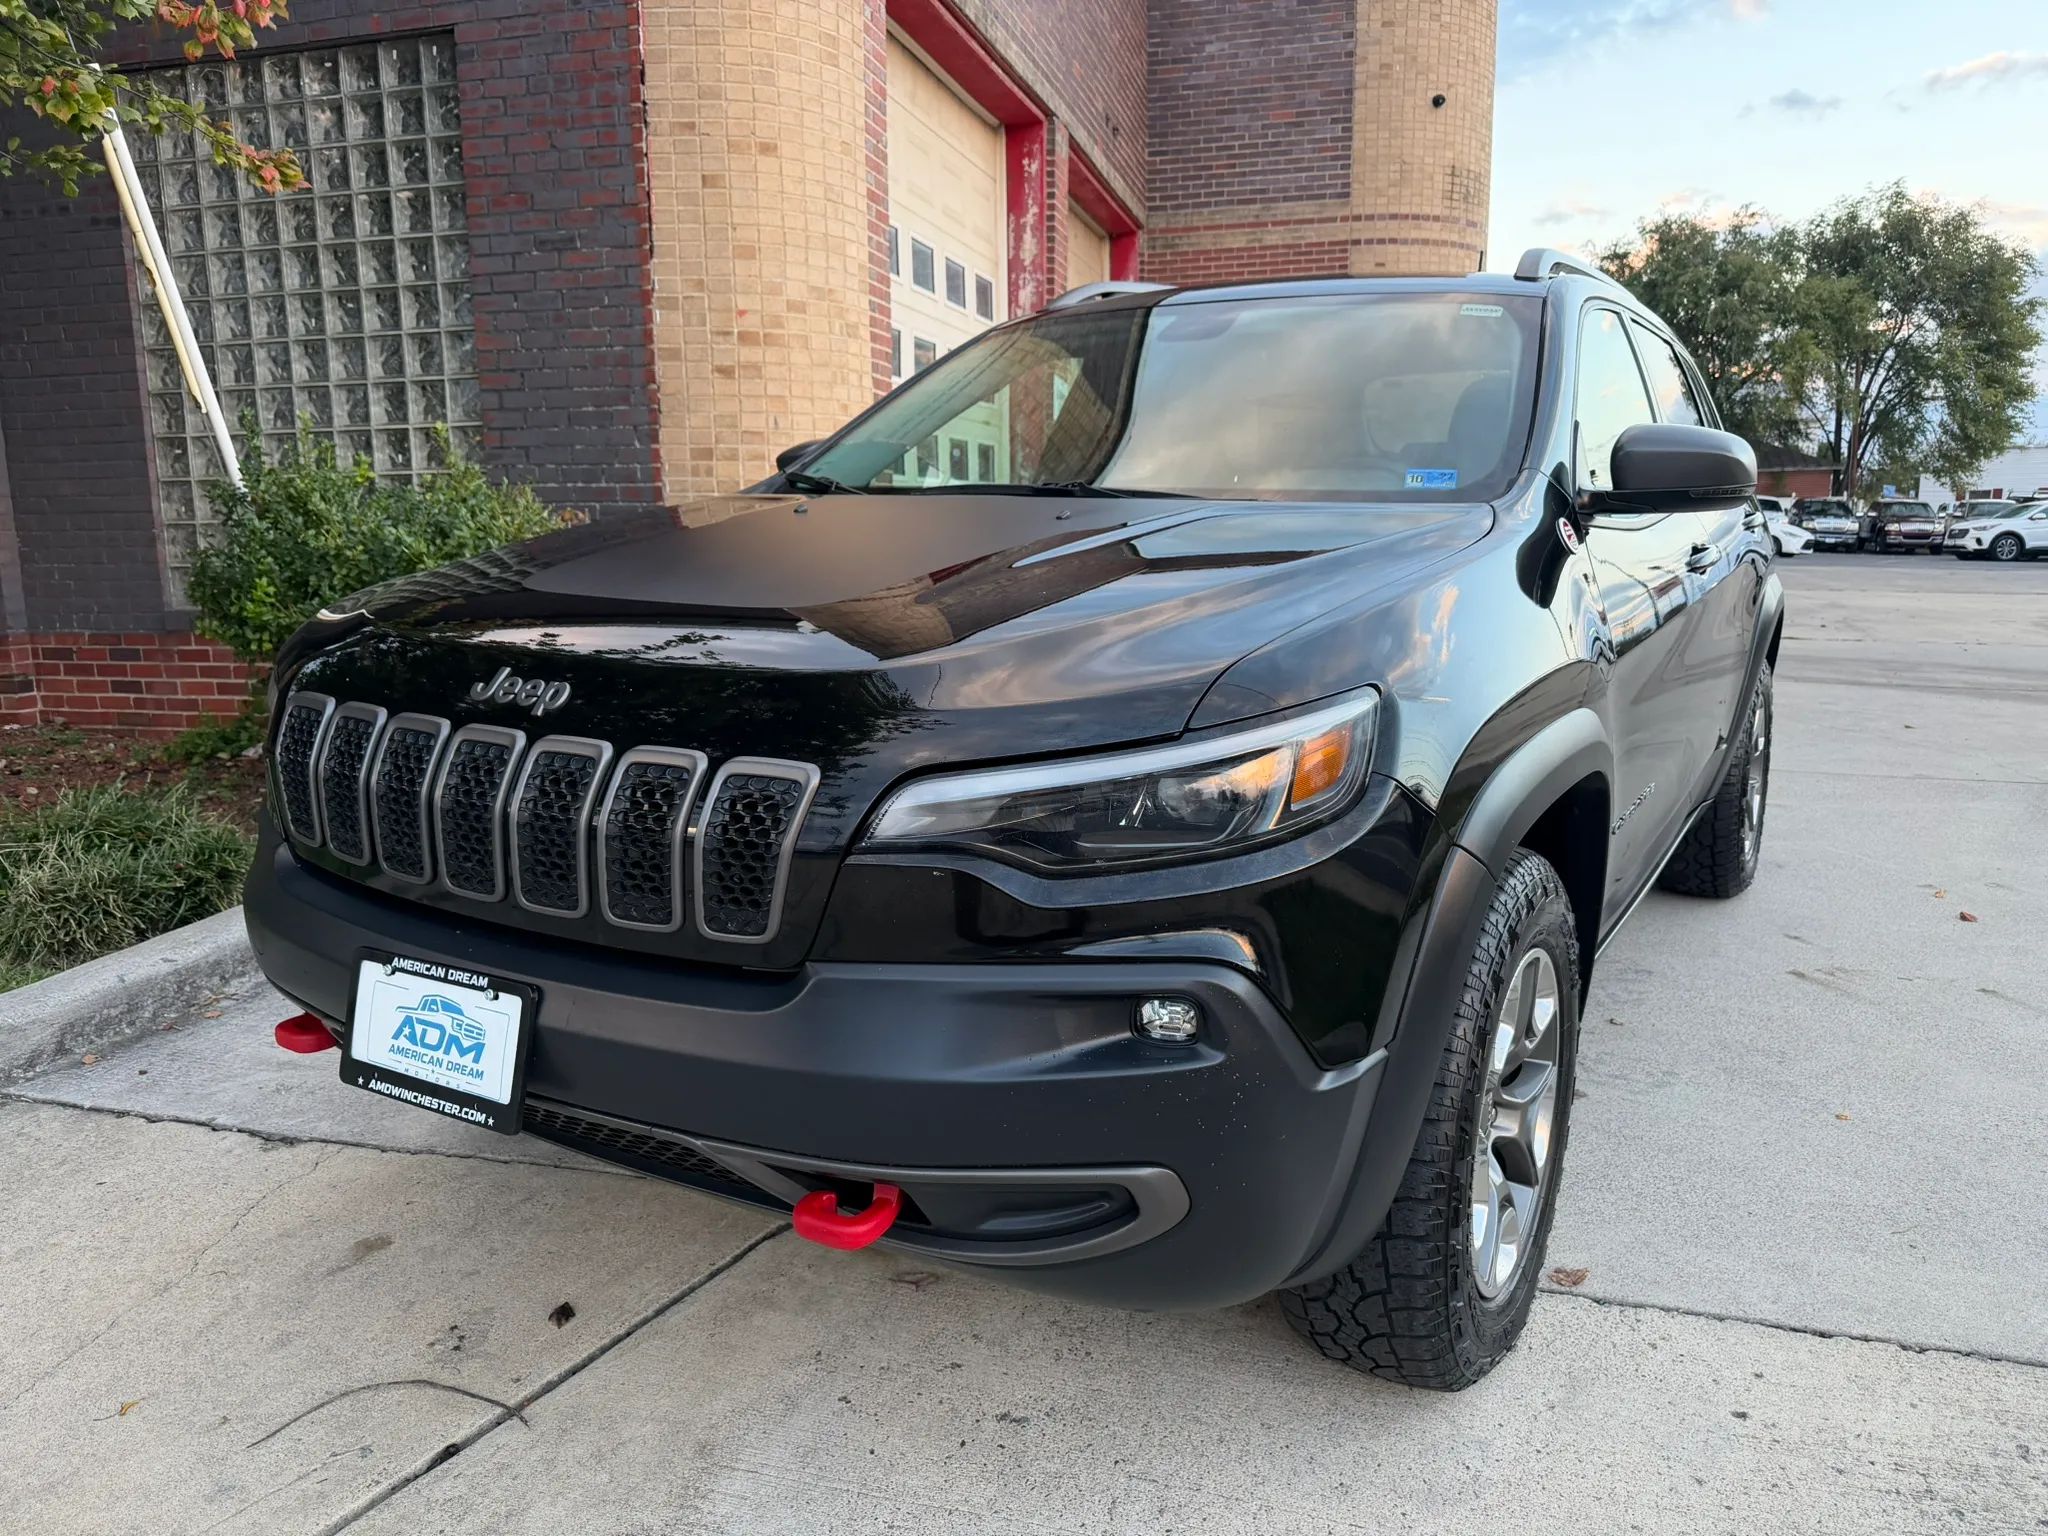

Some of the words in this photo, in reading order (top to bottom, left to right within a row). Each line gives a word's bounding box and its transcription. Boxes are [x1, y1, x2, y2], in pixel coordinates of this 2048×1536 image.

[470, 666, 571, 716] Jeep
[391, 956, 446, 979] AMERICAN
[447, 968, 489, 989] DREAM
[388, 1043, 444, 1069] AMERICAN
[445, 1060, 485, 1081] DREAM
[391, 1014, 486, 1065] ADM
[368, 1079, 487, 1124] AMDWINCHESTER.COM
